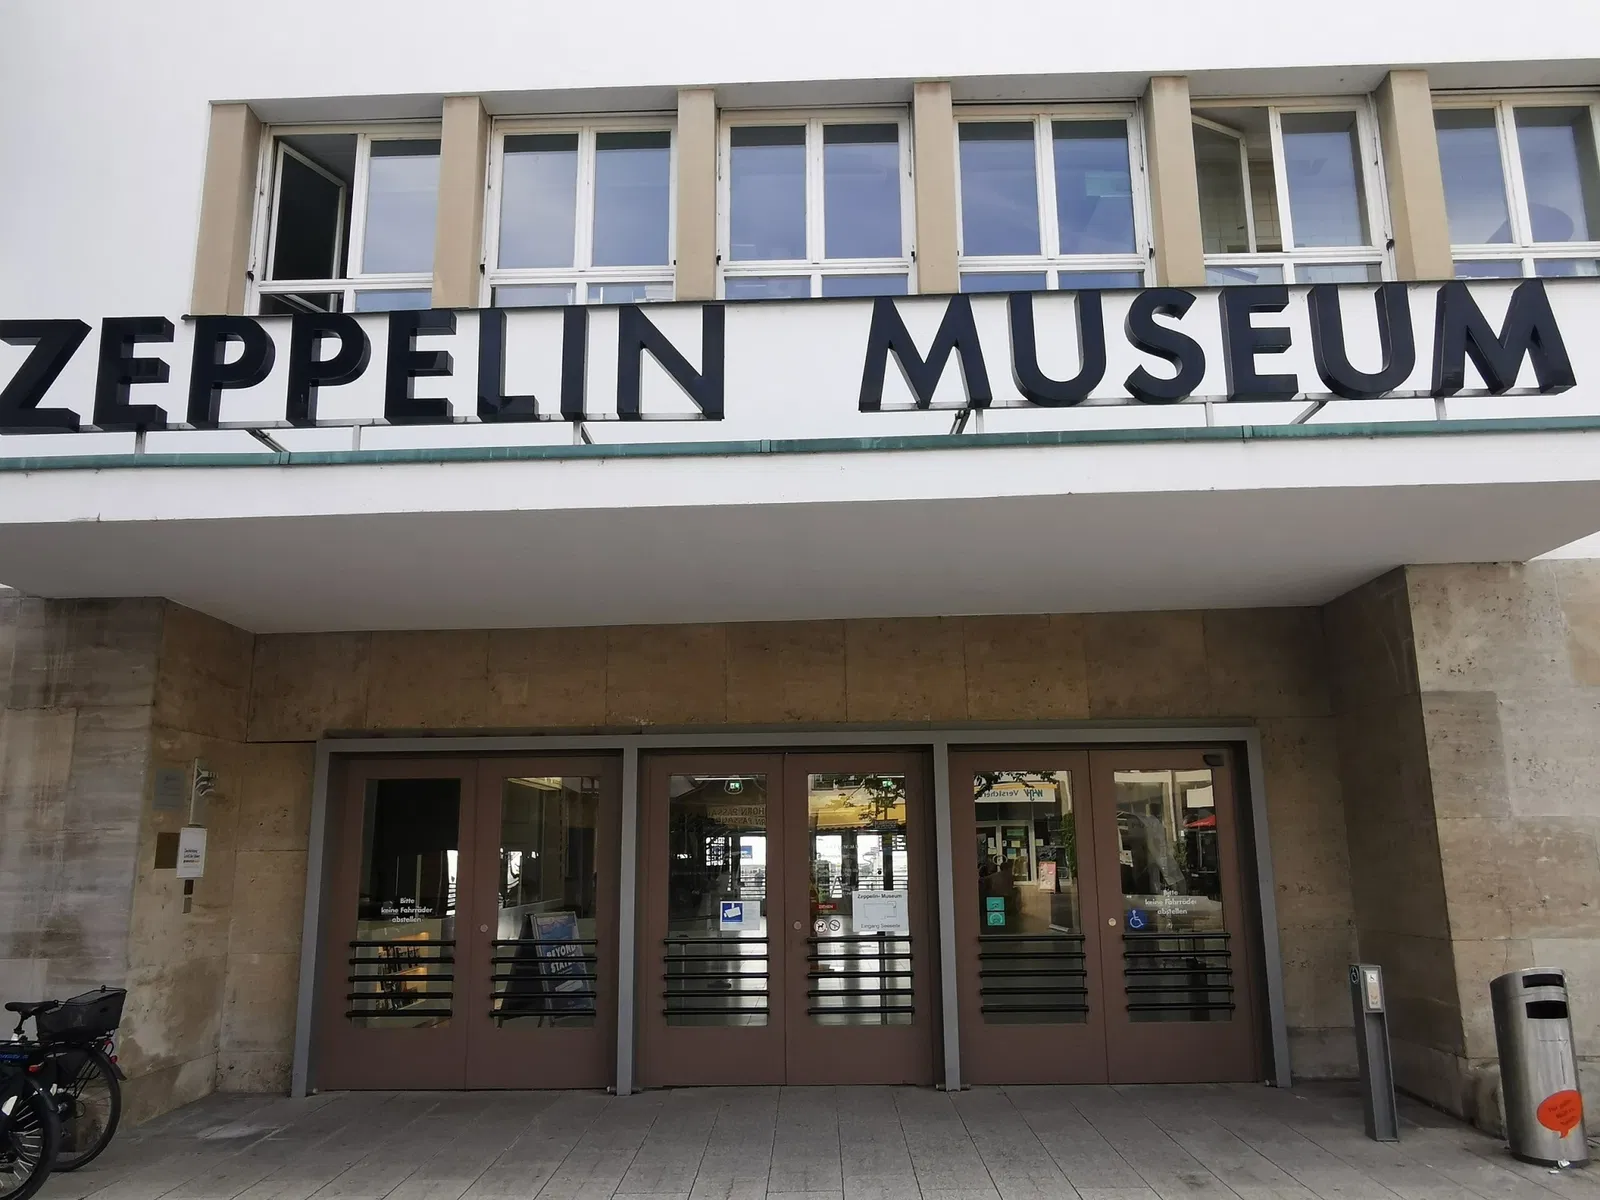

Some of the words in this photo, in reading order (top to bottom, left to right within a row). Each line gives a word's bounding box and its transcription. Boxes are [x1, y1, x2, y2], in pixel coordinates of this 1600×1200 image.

[0, 304, 725, 434] ZEPPELIN
[858, 278, 1577, 412] MUSEUM
[1145, 898, 1163, 906] keine
